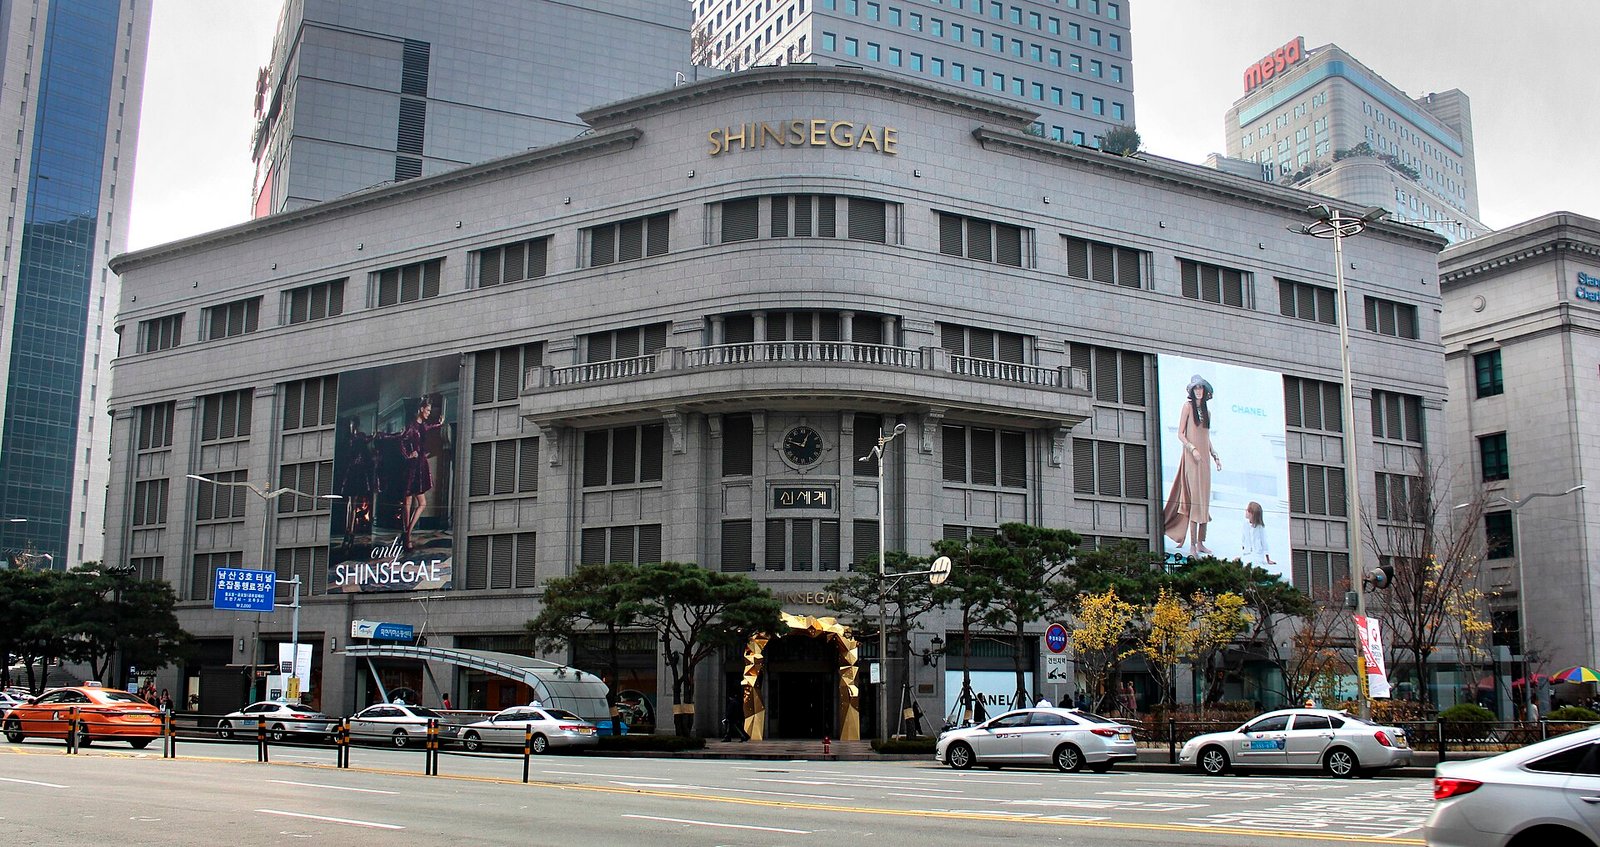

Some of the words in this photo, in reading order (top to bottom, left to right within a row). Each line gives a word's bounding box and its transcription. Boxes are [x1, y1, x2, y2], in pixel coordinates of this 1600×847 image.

[1244, 39, 1300, 92] mesa
[707, 119, 898, 155] SHINSEGAE
[1231, 404, 1267, 417] CHANEL
[780, 491, 827, 505] 신세계
[370, 536, 403, 563] only
[218, 570, 236, 581] 남산
[238, 572, 253, 581] 3호
[255, 573, 272, 583] 터널
[335, 560, 441, 586] SHINSEGAE
[218, 580, 272, 592] 혼잡통행료징수
[770, 591, 840, 605] HINSEGA
[959, 695, 1012, 706] ANEL
